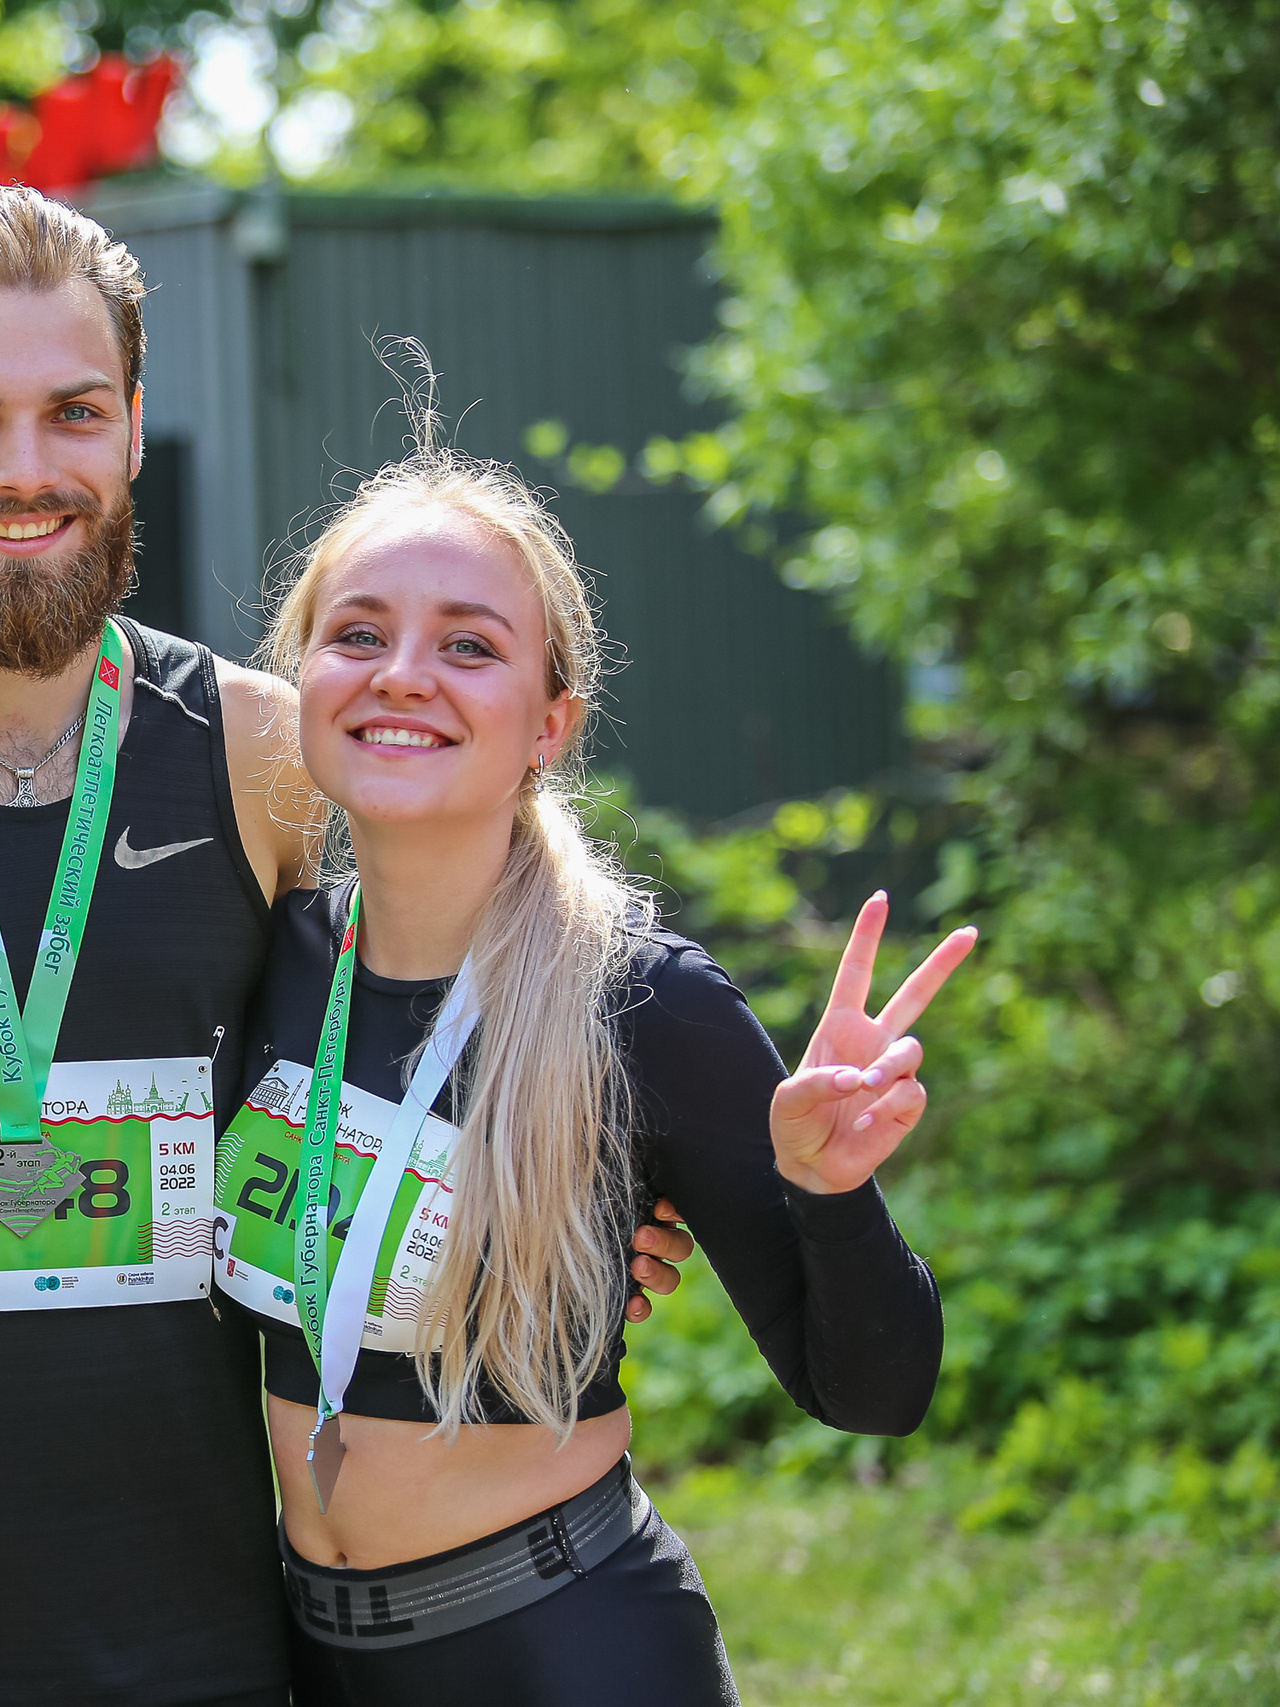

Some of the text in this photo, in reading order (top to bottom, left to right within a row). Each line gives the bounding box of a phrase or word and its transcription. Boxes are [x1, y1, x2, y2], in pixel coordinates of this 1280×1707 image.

[44, 697, 113, 975] Легкоатлетический забег
[308, 966, 348, 1147] Санкт-Петербурга
[159, 1142, 195, 1156] 5 КМ
[16, 1160, 41, 1168] этап
[160, 1164, 196, 1176] 04.06
[160, 1177, 196, 1190] 2022
[161, 1202, 196, 1216] 2 этап
[419, 1207, 432, 1221] 5
[300, 1154, 323, 1287] Губернатора
[400, 1265, 411, 1280] 2
